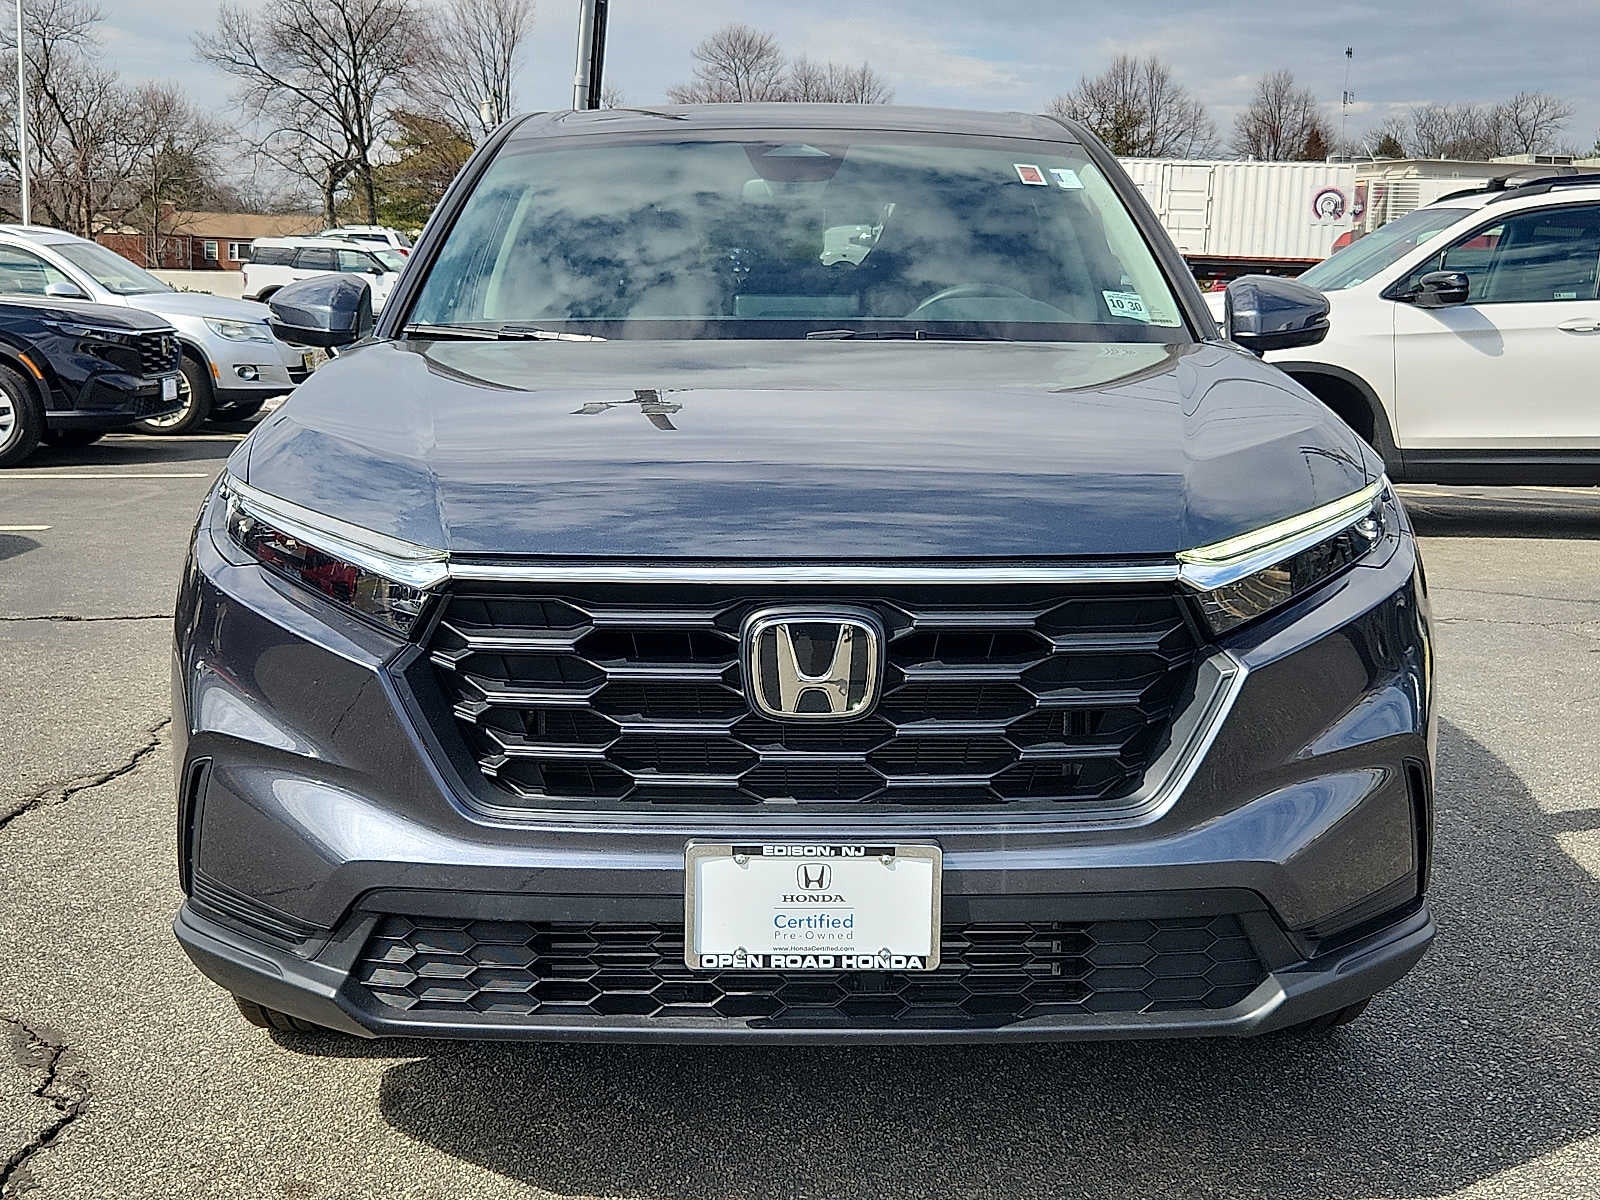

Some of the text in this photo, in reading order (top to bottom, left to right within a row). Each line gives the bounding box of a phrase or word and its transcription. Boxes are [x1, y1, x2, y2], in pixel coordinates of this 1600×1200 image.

[1109, 299, 1143, 311] 10 30
[762, 845, 866, 858] EDISON, NJ
[781, 894, 847, 903] HONDA
[774, 913, 854, 929] Certified
[774, 930, 854, 940] Pre-Owned
[701, 954, 924, 970] OPEN ROAD HONDA
